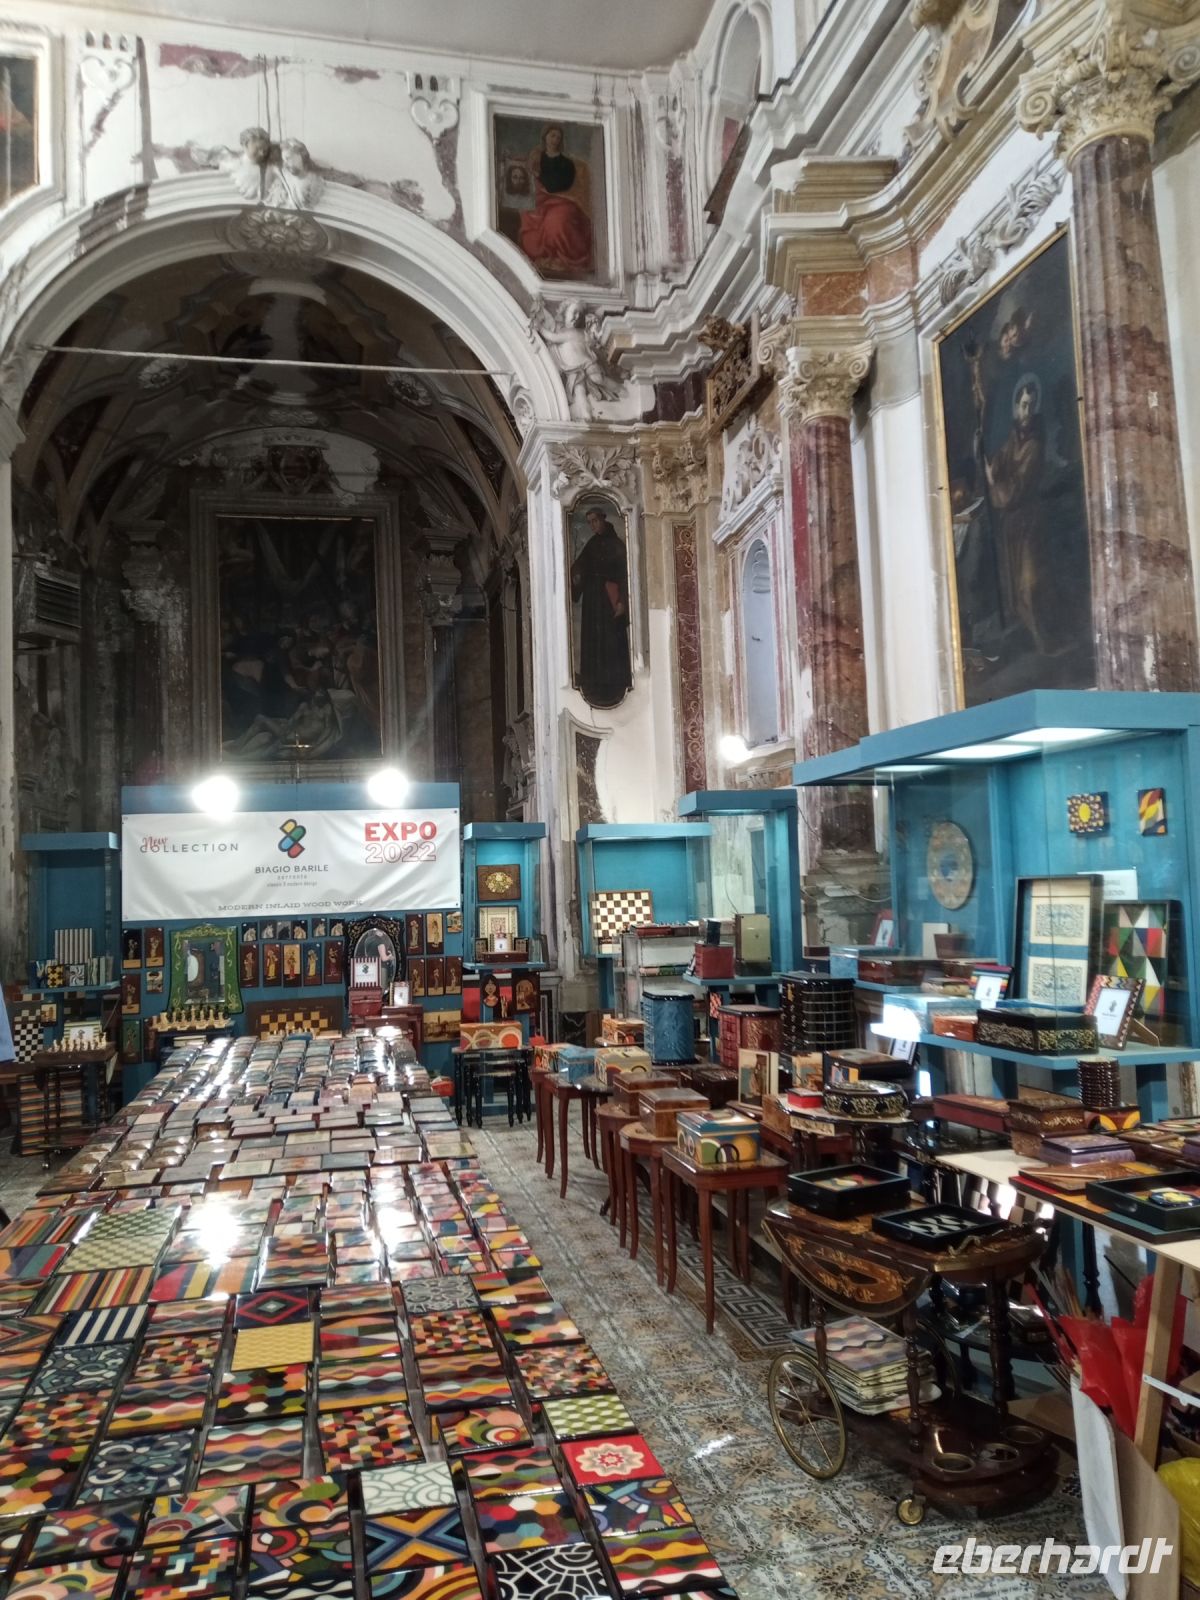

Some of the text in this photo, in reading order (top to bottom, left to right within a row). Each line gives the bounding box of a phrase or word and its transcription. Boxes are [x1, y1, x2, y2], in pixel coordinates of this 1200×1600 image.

[365, 821, 437, 841] EXPO
[140, 843, 239, 853] COLLECTION
[142, 836, 168, 850] New
[365, 841, 437, 864] 2022
[294, 864, 329, 873] BARILE
